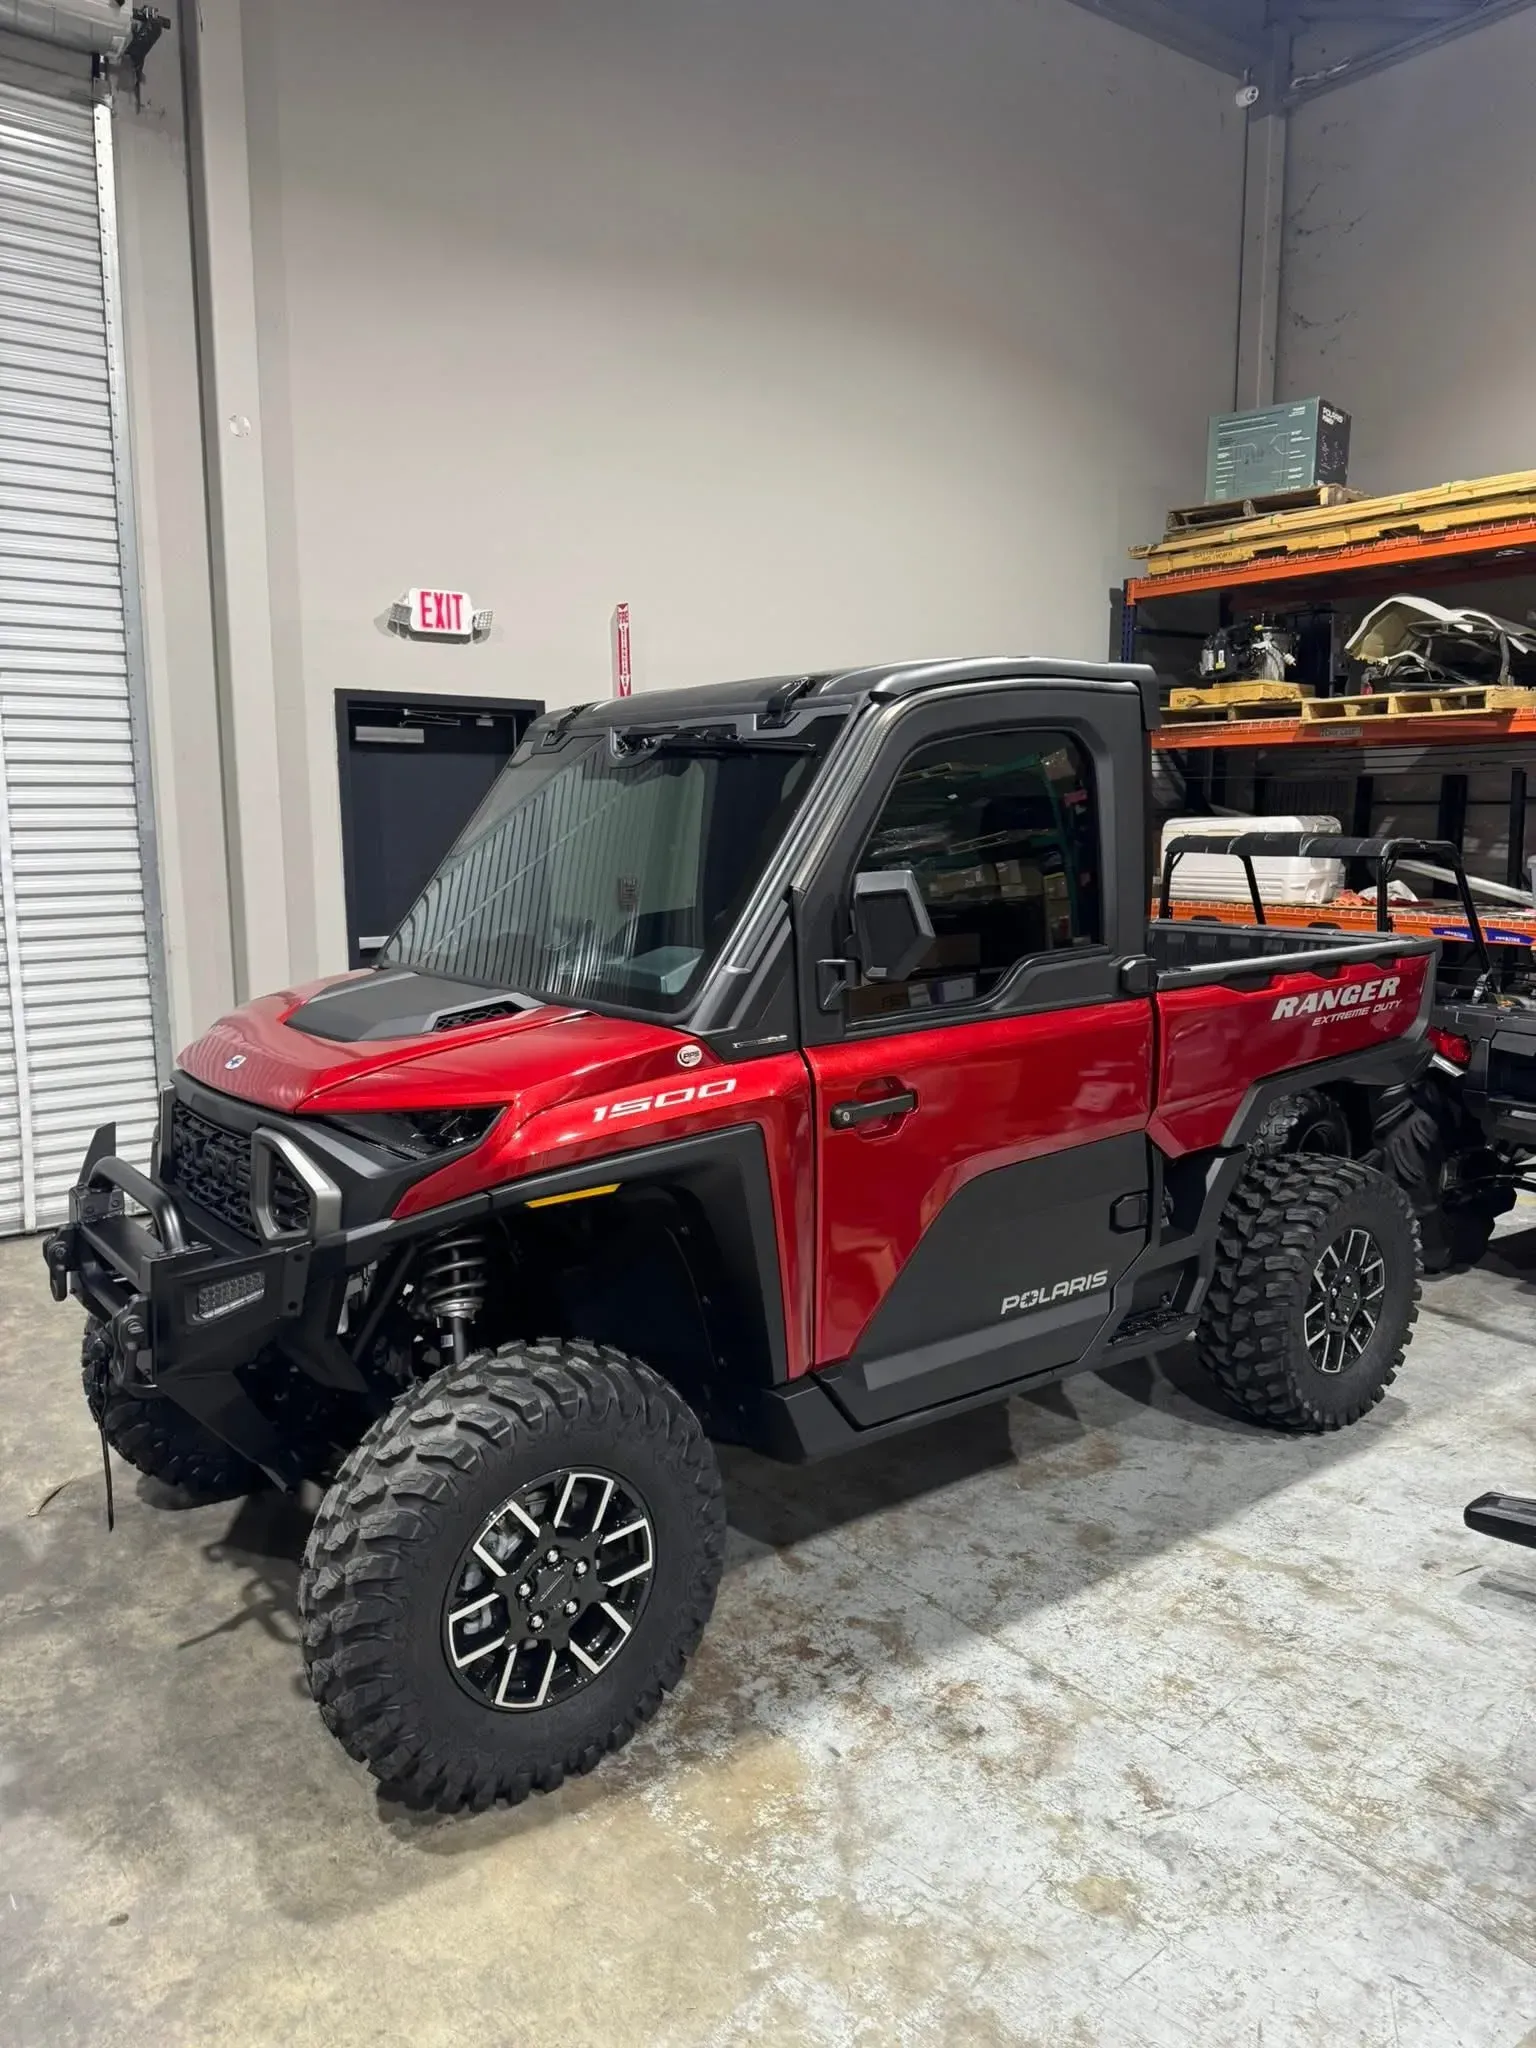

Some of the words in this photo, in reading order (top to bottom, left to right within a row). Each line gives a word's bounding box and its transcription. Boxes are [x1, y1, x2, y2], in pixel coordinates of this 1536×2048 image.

[420, 591, 463, 630] EXIT
[1271, 976, 1401, 1021] RANGER
[1311, 1006, 1370, 1027] EXTREME
[1372, 999, 1403, 1014] DUTY
[592, 1078, 737, 1123] 1500
[1000, 1269, 1109, 1315] POLARIS
